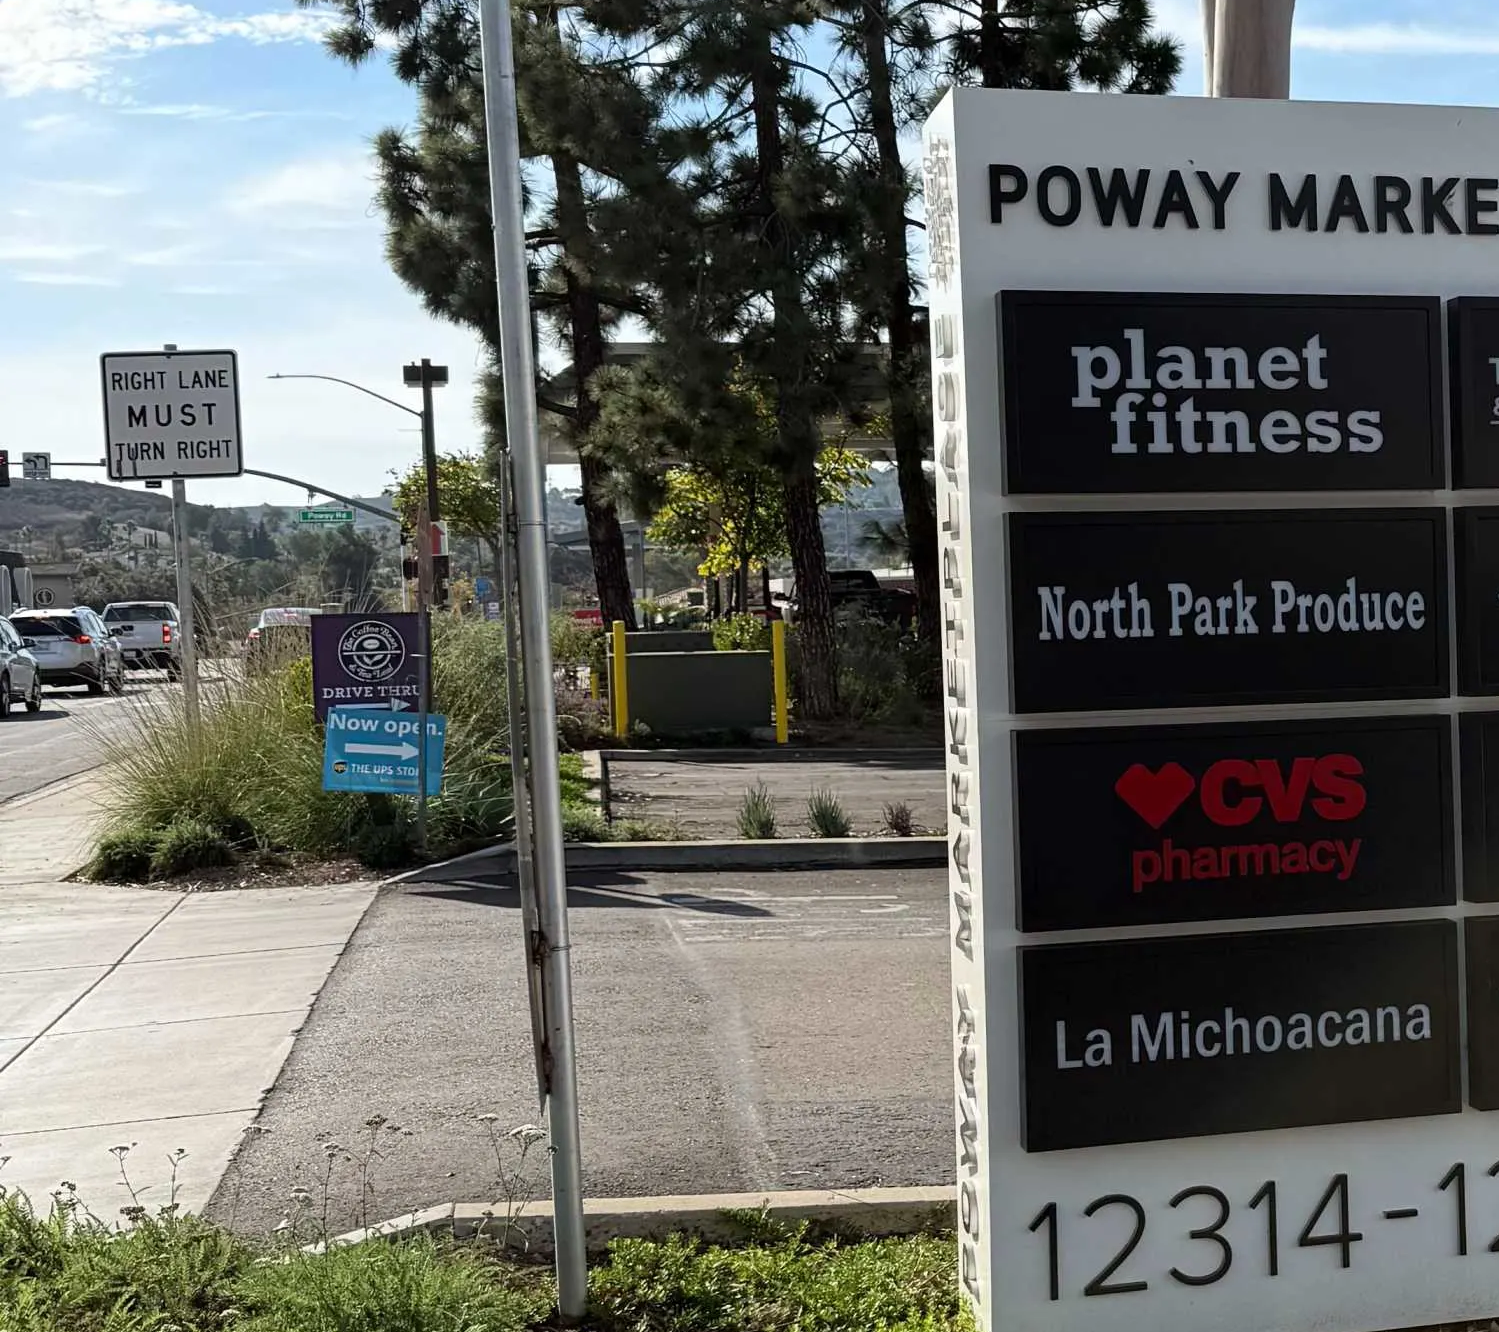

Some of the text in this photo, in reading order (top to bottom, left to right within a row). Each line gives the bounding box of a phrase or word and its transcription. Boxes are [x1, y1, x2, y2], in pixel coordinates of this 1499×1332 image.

[988, 163, 1241, 230] POWAY
[111, 370, 229, 391] RIGHT LANE
[1071, 328, 1329, 409] planet
[128, 403, 217, 428] MUST
[1110, 392, 1384, 455] fitness
[115, 440, 232, 461] TURN RIGHT
[1037, 575, 1427, 642] North Park Produce
[935, 313, 974, 963] MARKETPLACE
[322, 685, 420, 699] DRIVE THRU
[329, 713, 379, 732] Now
[350, 763, 372, 774] THE
[374, 764, 394, 775] UPS
[1200, 754, 1367, 827] CVS
[1132, 839, 1360, 893] pharmacy
[1056, 1003, 1433, 1069] La Michoacana
